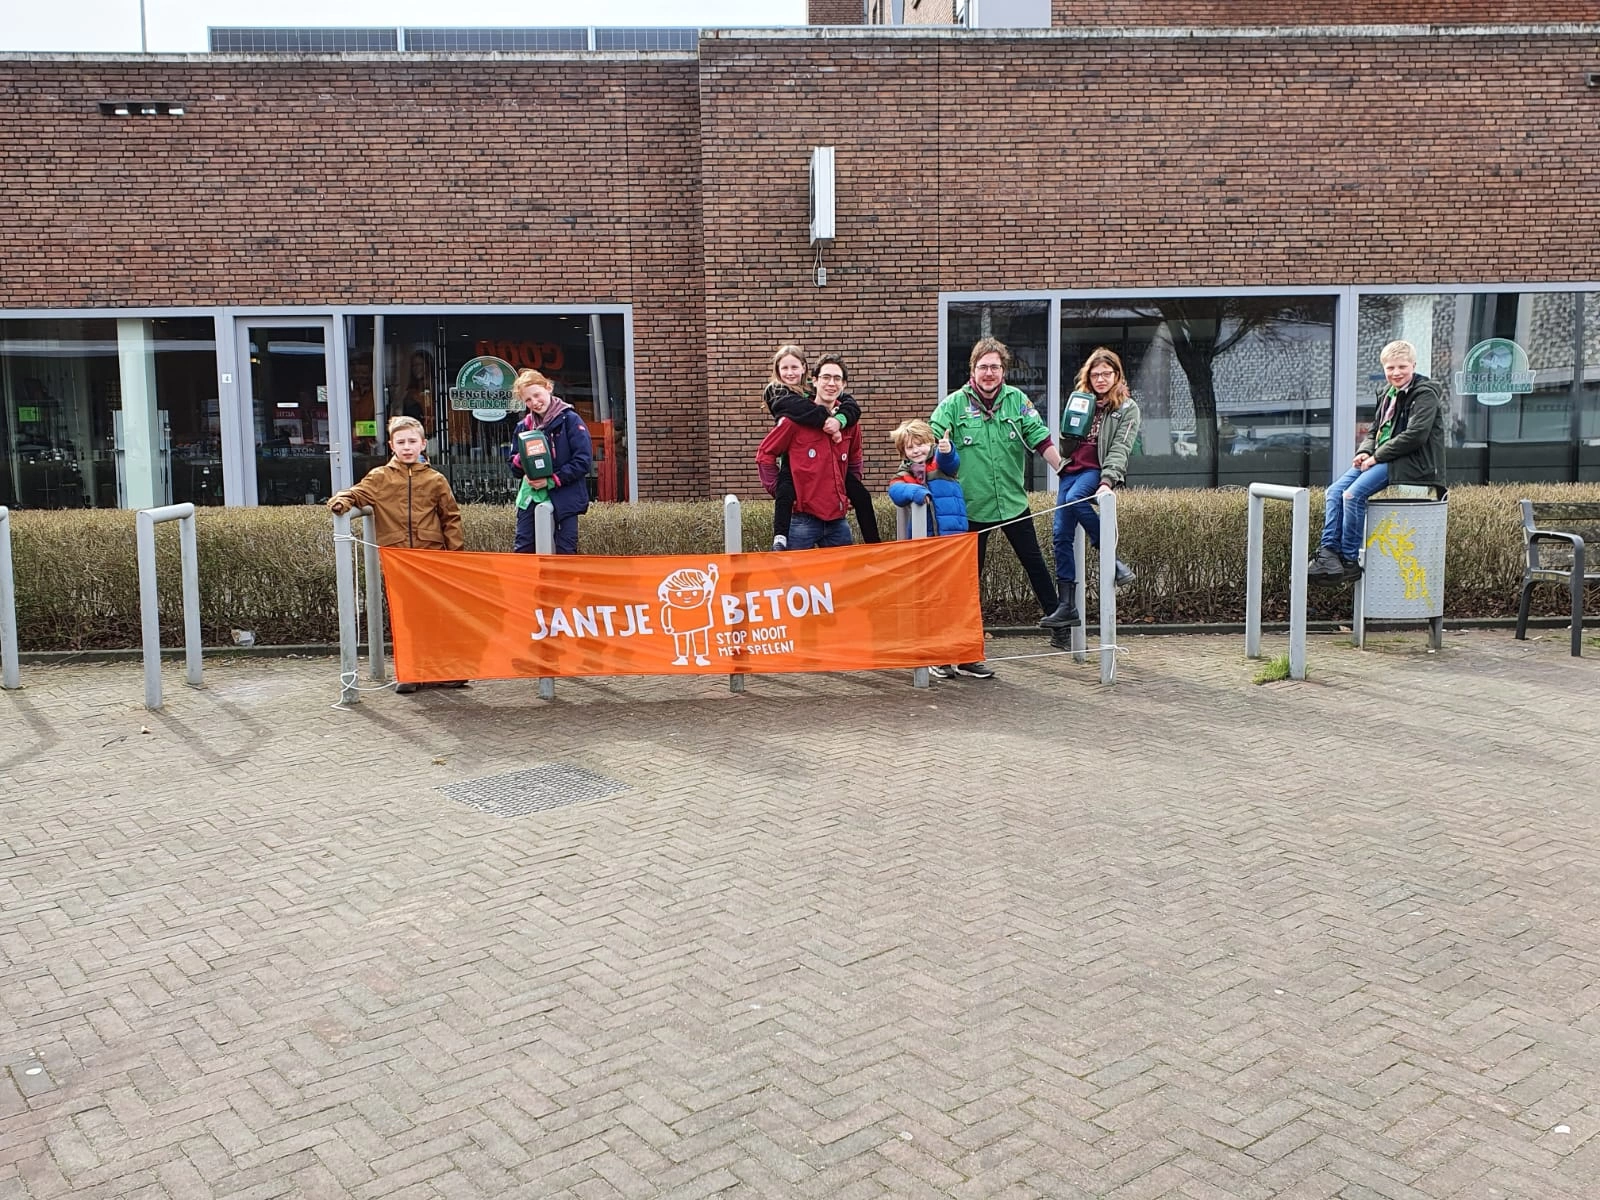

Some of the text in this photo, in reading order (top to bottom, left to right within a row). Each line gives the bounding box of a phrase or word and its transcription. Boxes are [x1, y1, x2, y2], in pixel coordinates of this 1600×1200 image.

[451, 390, 514, 400] HENGELSPO
[531, 582, 834, 640] JANTJE BETON
[716, 625, 787, 645] STOP NOOIT
[718, 639, 794, 657] MET SPELEN!
